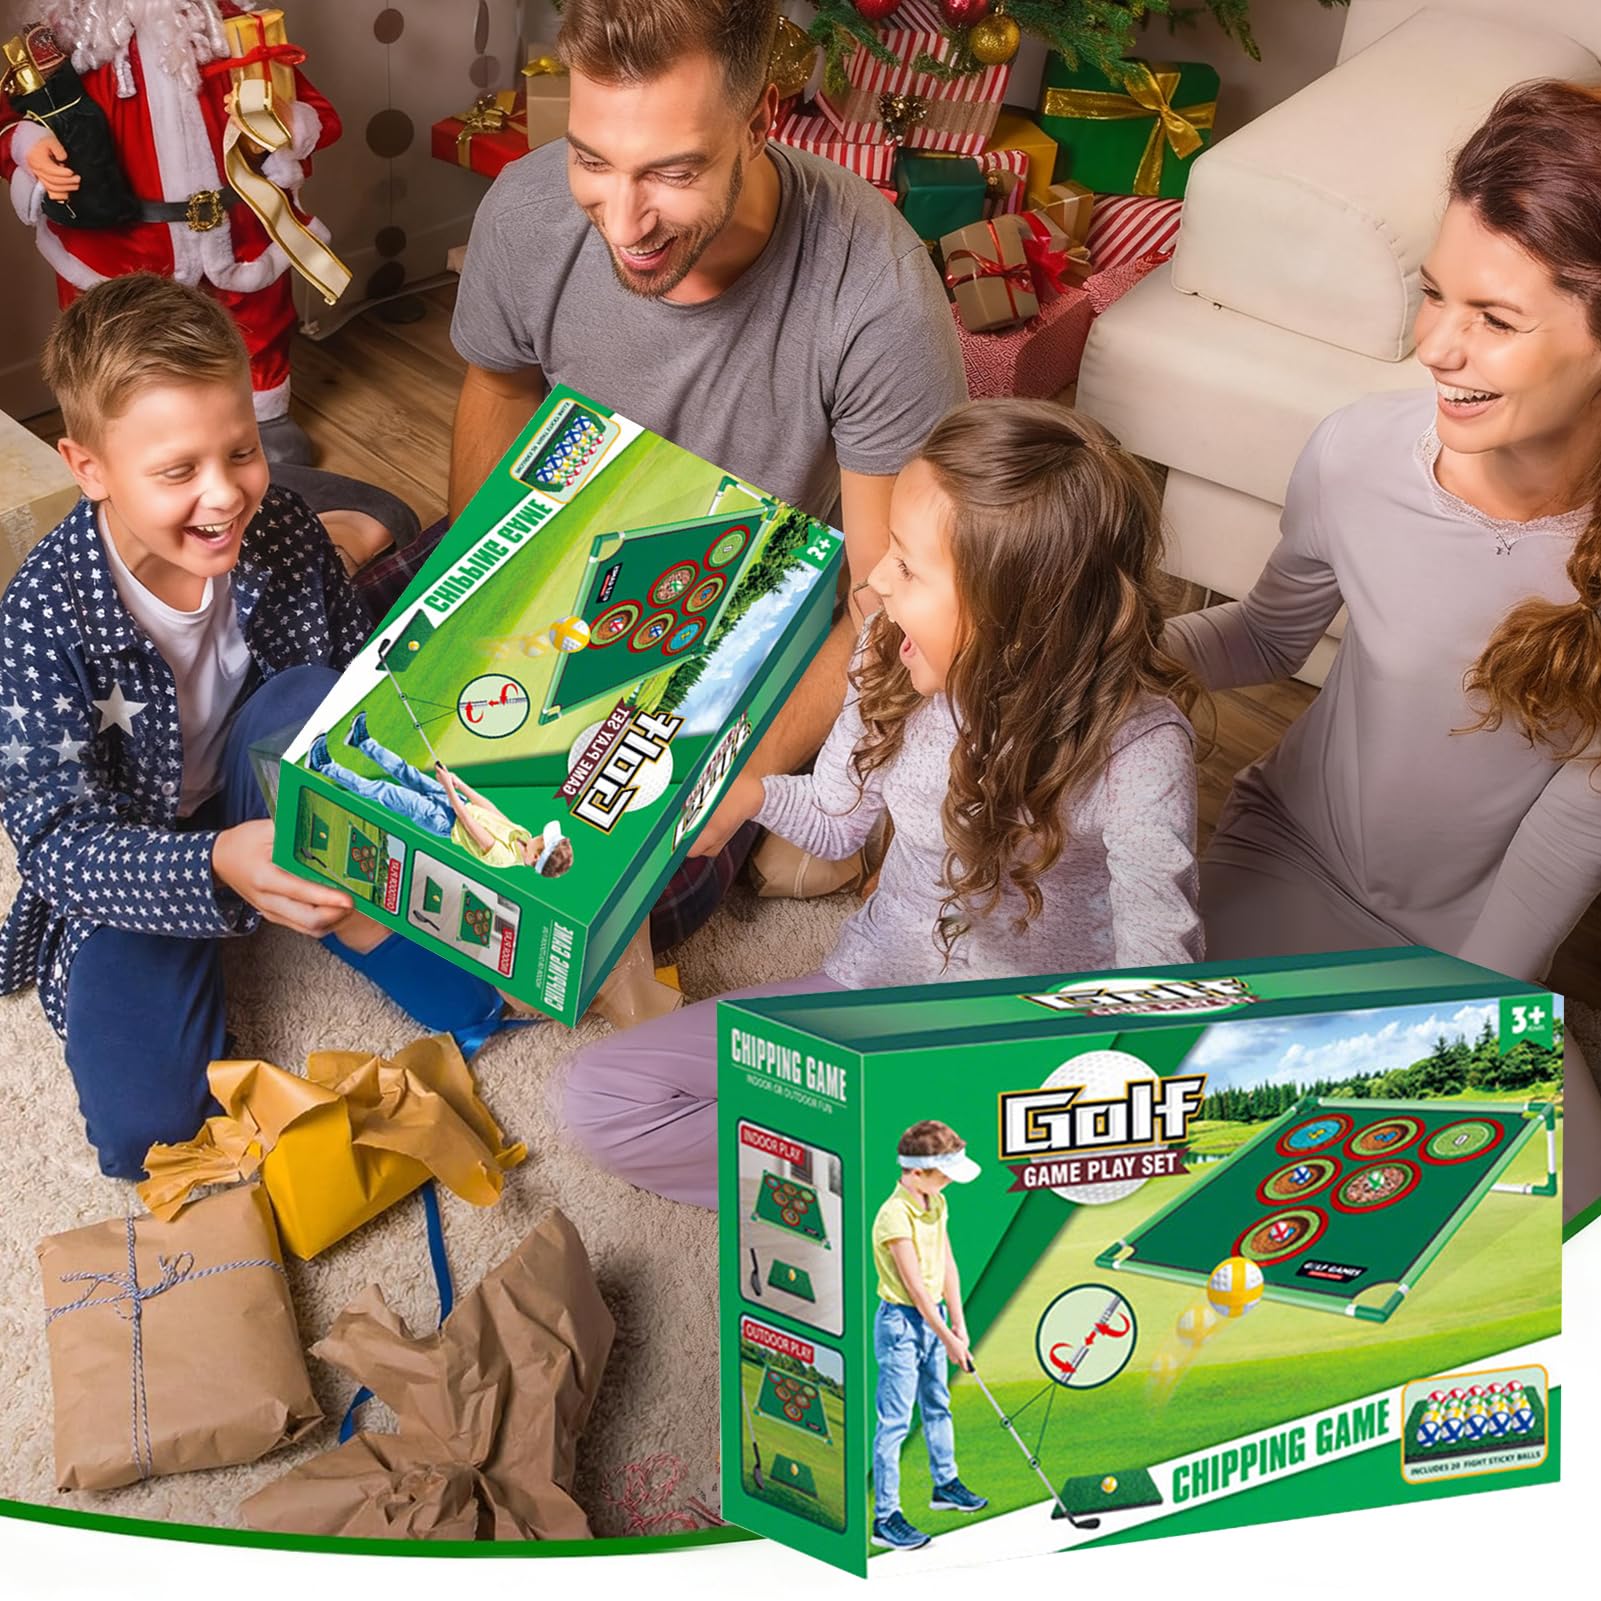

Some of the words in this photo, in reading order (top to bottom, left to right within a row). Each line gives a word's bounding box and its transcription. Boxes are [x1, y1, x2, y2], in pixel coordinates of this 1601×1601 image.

[1511, 1005, 1547, 1034] 3+
[731, 1027, 802, 1085] CHIPPING
[806, 1055, 847, 1103] GAME
[998, 1073, 1209, 1160] Golf
[743, 1128, 778, 1153] INDOOR
[779, 1141, 802, 1162] PLAY
[1023, 1162, 1081, 1188] GAME
[1087, 1156, 1136, 1182] PLAY
[1141, 1153, 1178, 1176] SET
[745, 1323, 789, 1352] OUTDOOR
[790, 1340, 813, 1360] PLAY
[1172, 1426, 1306, 1504] CHIPPING
[1315, 1398, 1390, 1456] GAME
[1410, 1464, 1449, 1476] INCLUDES
